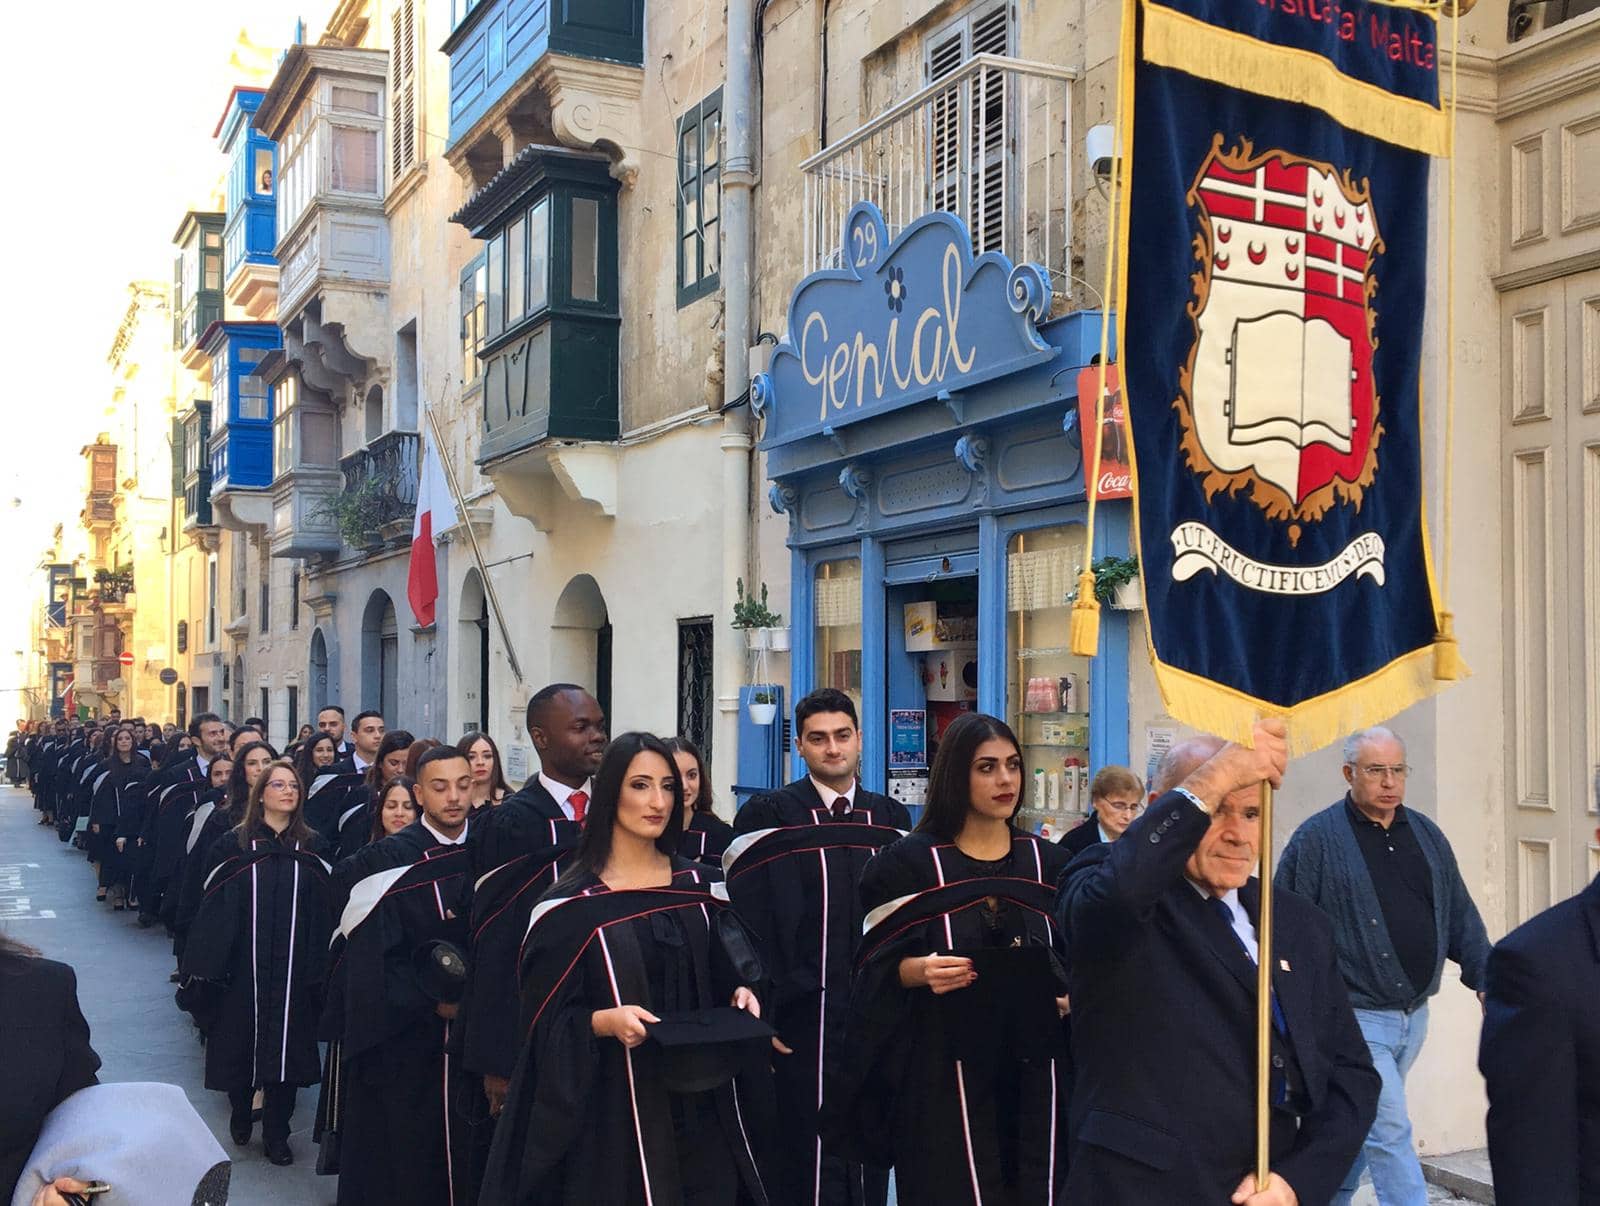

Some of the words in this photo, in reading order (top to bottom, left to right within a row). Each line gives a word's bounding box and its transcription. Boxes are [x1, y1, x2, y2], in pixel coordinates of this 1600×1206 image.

[1370, 14, 1434, 69] Malta
[854, 222, 877, 267] 29
[802, 242, 976, 421] Genial
